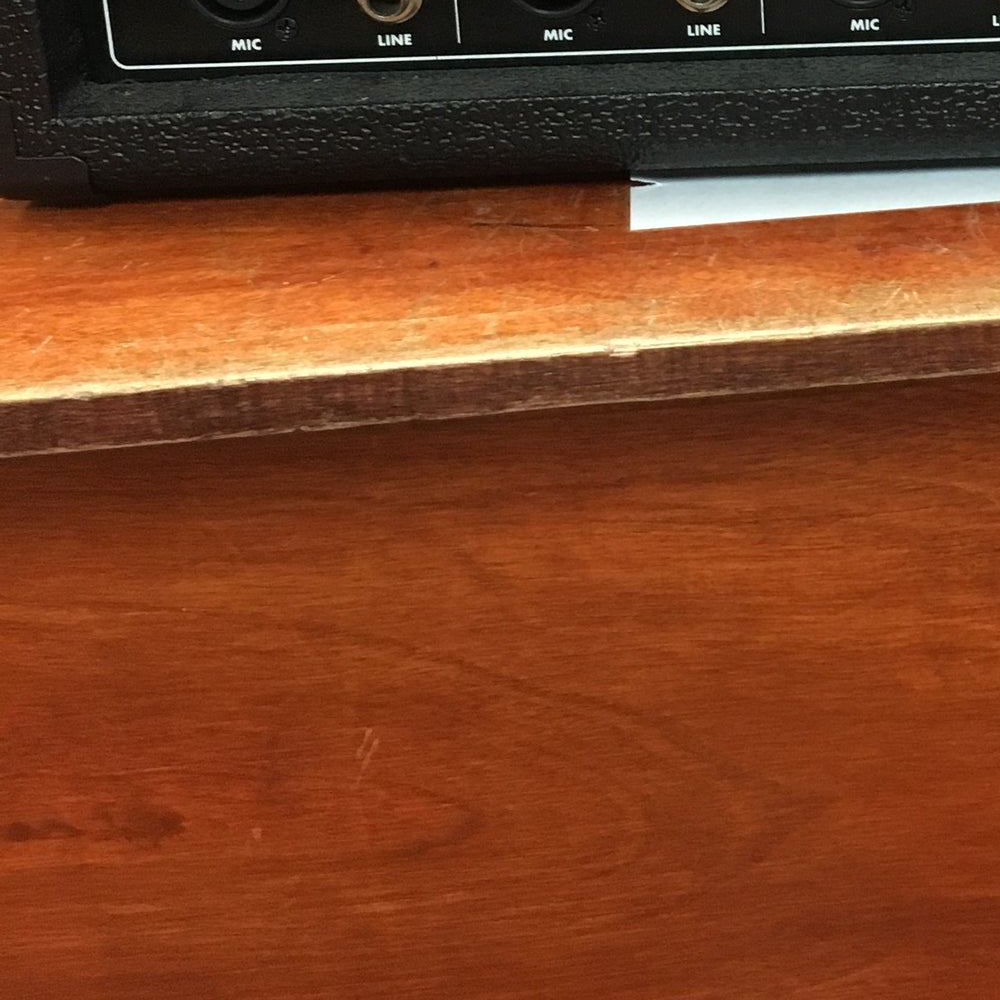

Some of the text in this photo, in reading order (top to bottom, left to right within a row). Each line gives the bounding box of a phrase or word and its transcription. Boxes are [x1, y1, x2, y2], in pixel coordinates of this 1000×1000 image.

[687, 24, 722, 37] LINE
[850, 18, 880, 31] MIC
[377, 33, 413, 47] LINE
[543, 28, 574, 41] MIC
[231, 38, 263, 52] MIC
